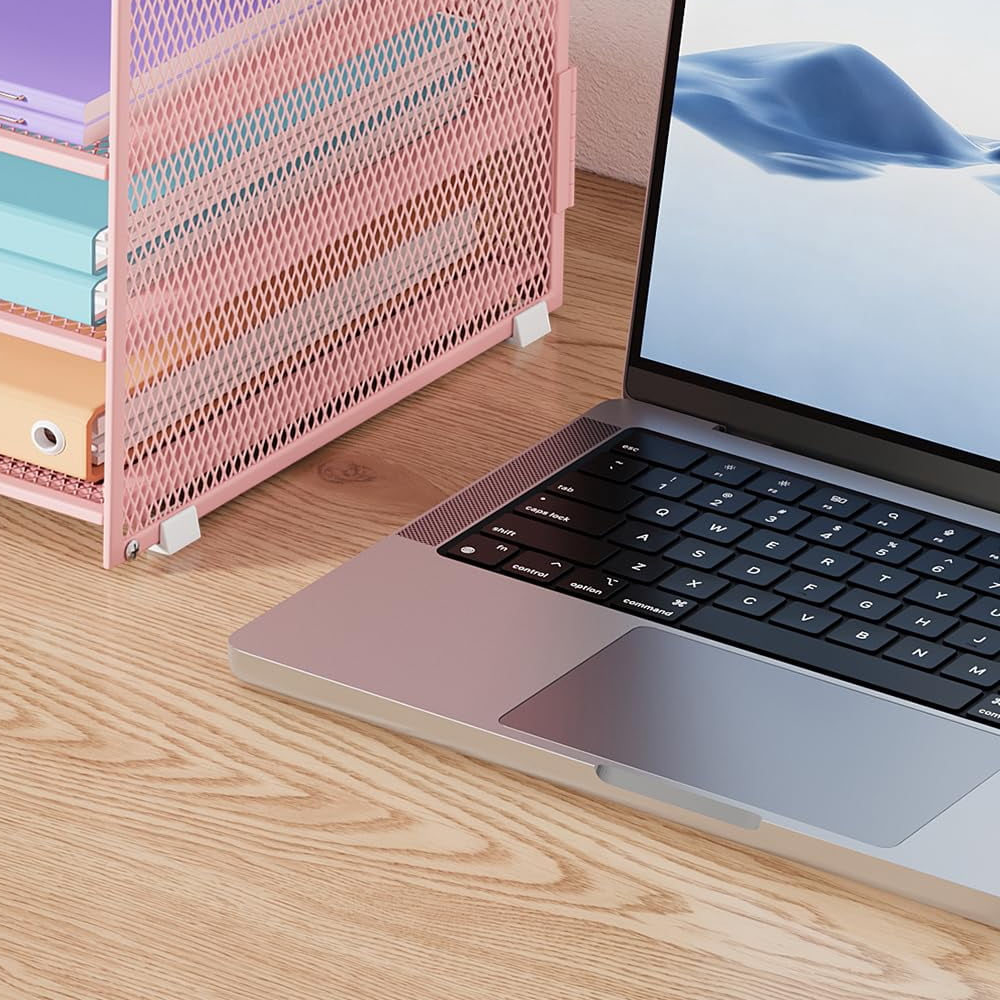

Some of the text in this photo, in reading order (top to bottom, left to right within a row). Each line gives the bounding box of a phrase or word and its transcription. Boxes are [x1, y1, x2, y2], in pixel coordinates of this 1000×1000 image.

[622, 444, 640, 453] esc
[557, 484, 574, 493] tab
[709, 498, 723, 507] 2
[524, 504, 571, 523] caps lock
[655, 508, 670, 517] Q
[764, 515, 778, 523] 3
[491, 526, 517, 537] shift
[709, 523, 728, 533] W
[636, 533, 650, 542] A
[819, 532, 833, 540] 4
[496, 544, 509, 552] fn
[765, 541, 780, 550] E
[691, 549, 706, 558] S
[875, 548, 889, 556] 5
[820, 557, 835, 566] R
[512, 563, 549, 579] control
[631, 562, 647, 571] Z
[746, 566, 761, 575] D
[931, 565, 945, 573] 6
[879, 573, 892, 582] T
[686, 579, 702, 588] X
[802, 583, 818, 591] F
[570, 581, 603, 596] option
[935, 591, 949, 600] Y
[743, 596, 758, 605] C
[859, 600, 874, 609] G
[623, 598, 674, 618] command
[800, 613, 815, 622] V
[914, 617, 931, 627] H
[855, 630, 870, 640] B
[911, 648, 929, 658] N
[968, 665, 987, 676] M
